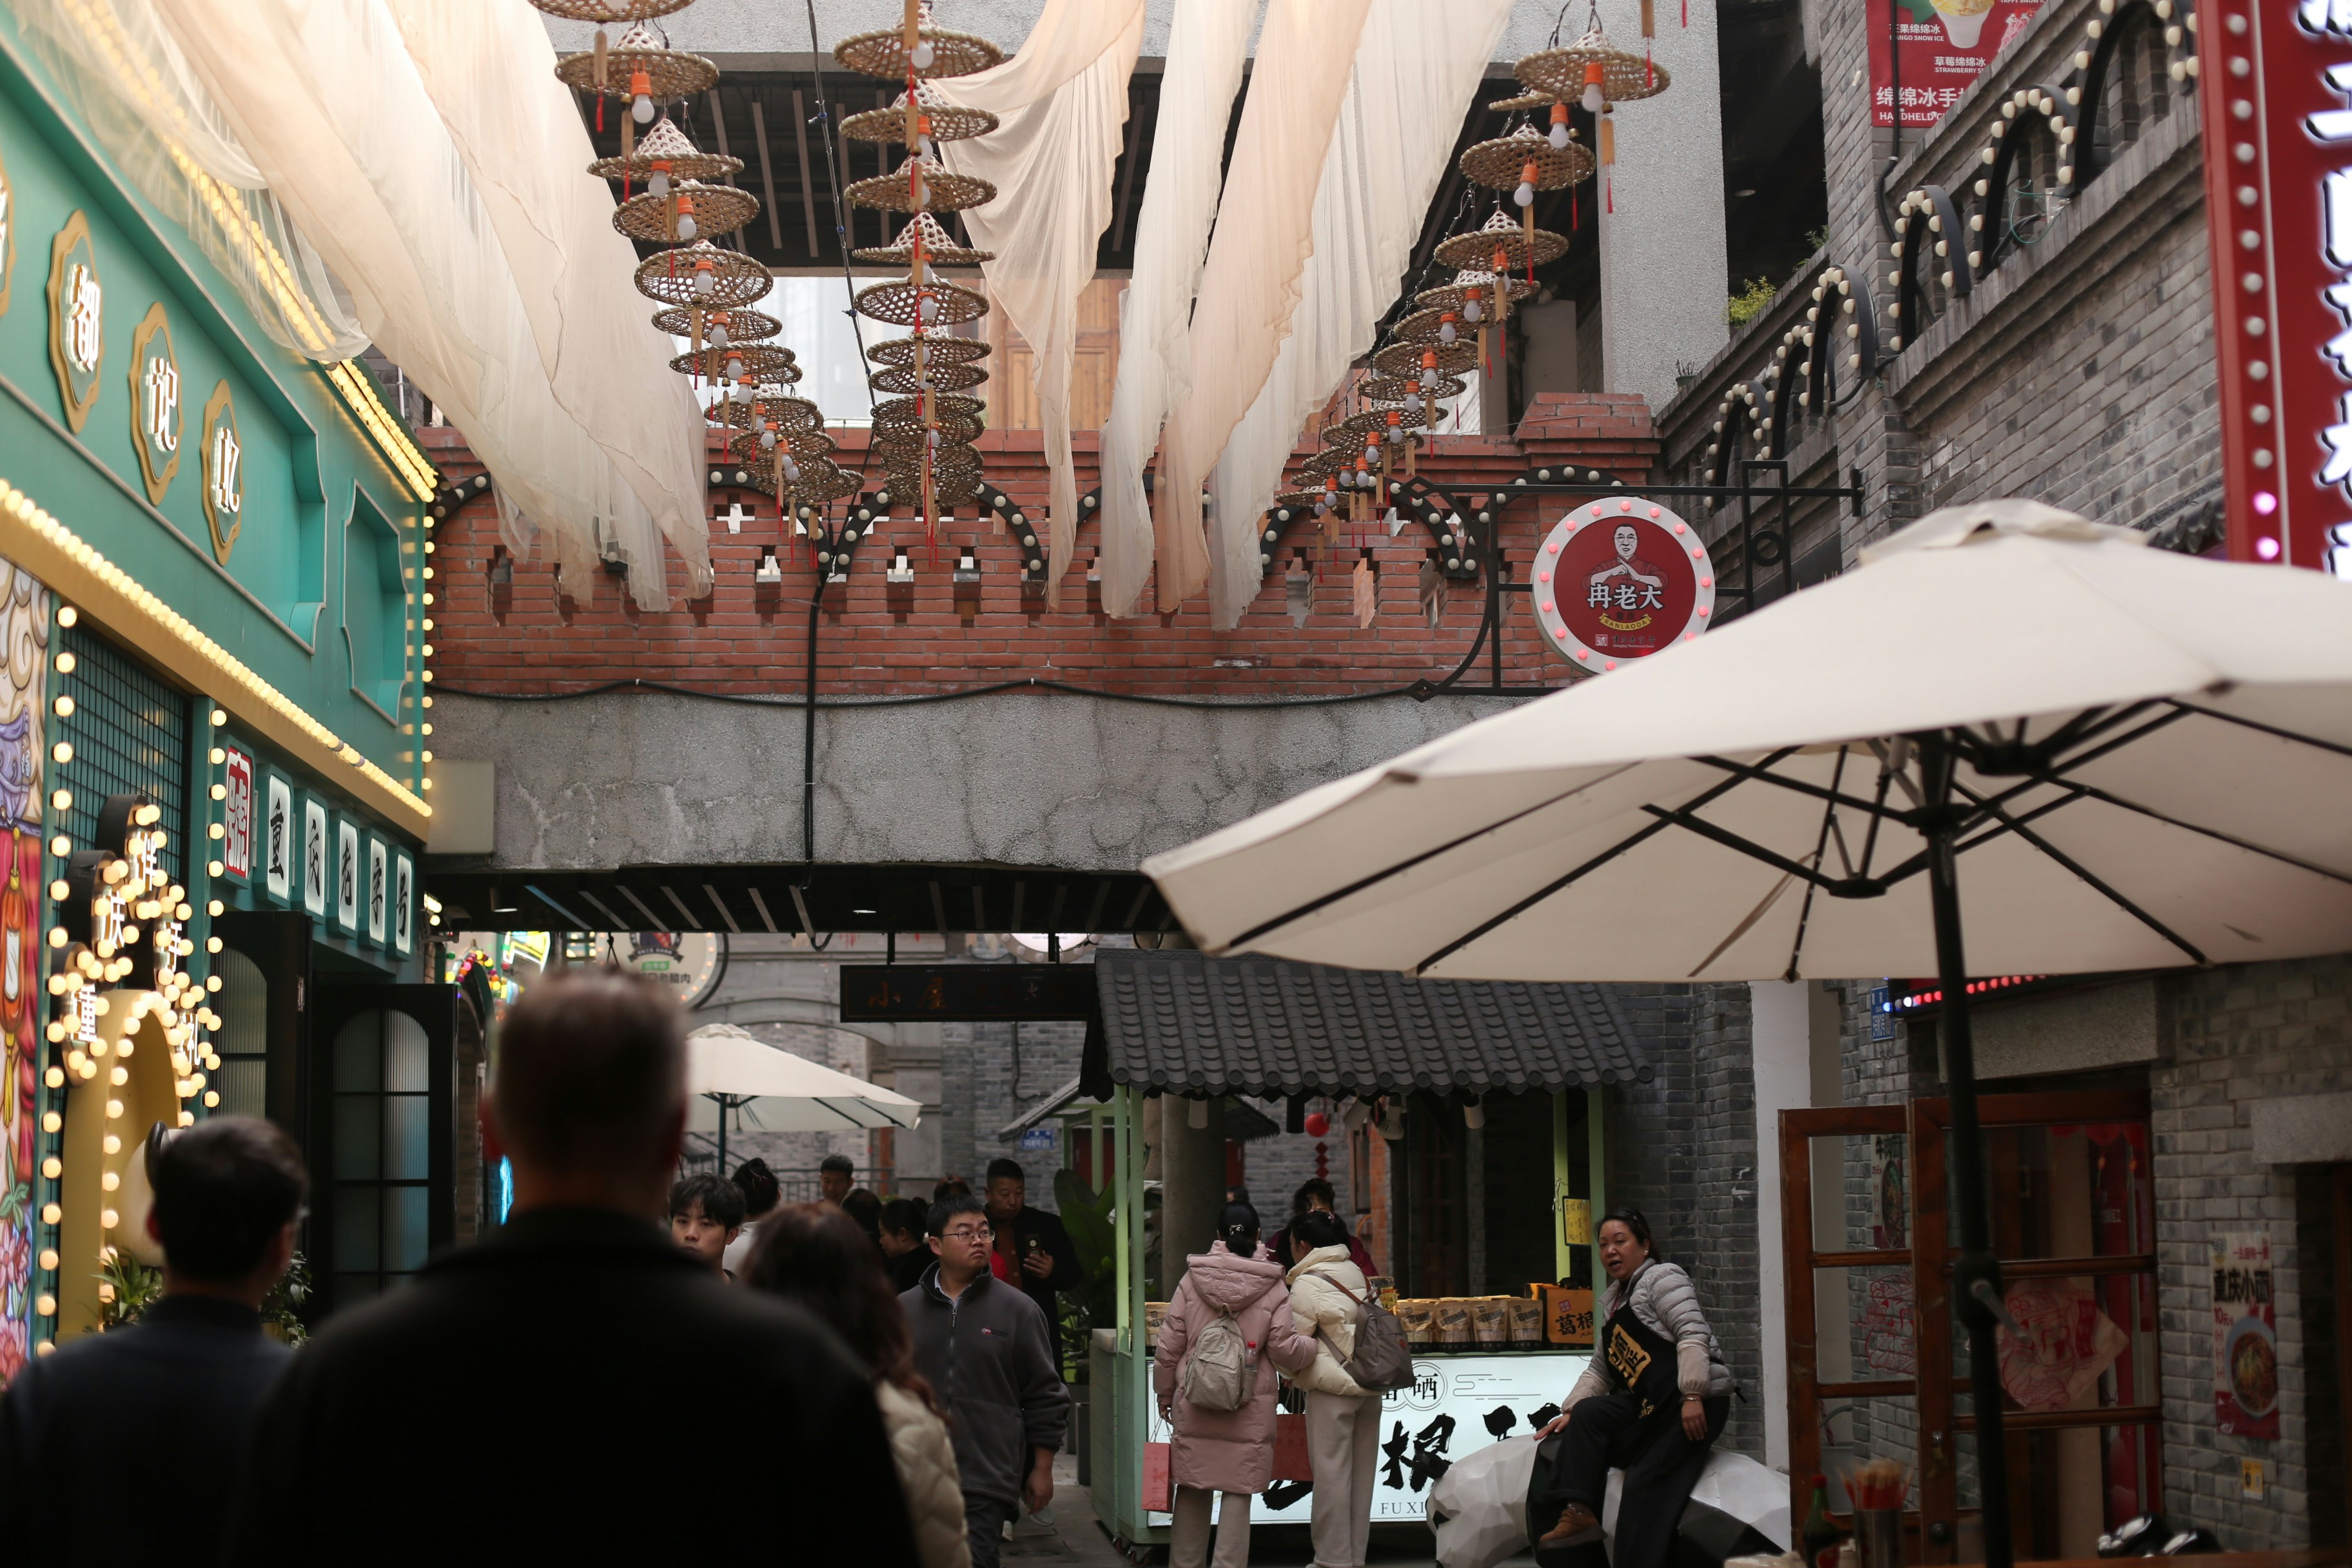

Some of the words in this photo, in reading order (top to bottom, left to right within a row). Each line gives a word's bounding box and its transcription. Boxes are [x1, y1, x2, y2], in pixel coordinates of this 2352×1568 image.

[1934, 56, 1986, 67] 草莓绵绵冰
[1876, 86, 1965, 108] 绵绵冰手
[1879, 112, 1934, 121] HADHELD
[1587, 582, 1663, 611] 冉老大
[1604, 618, 1648, 630] RANLAODA
[2214, 1268, 2270, 1304] 重庆小面
